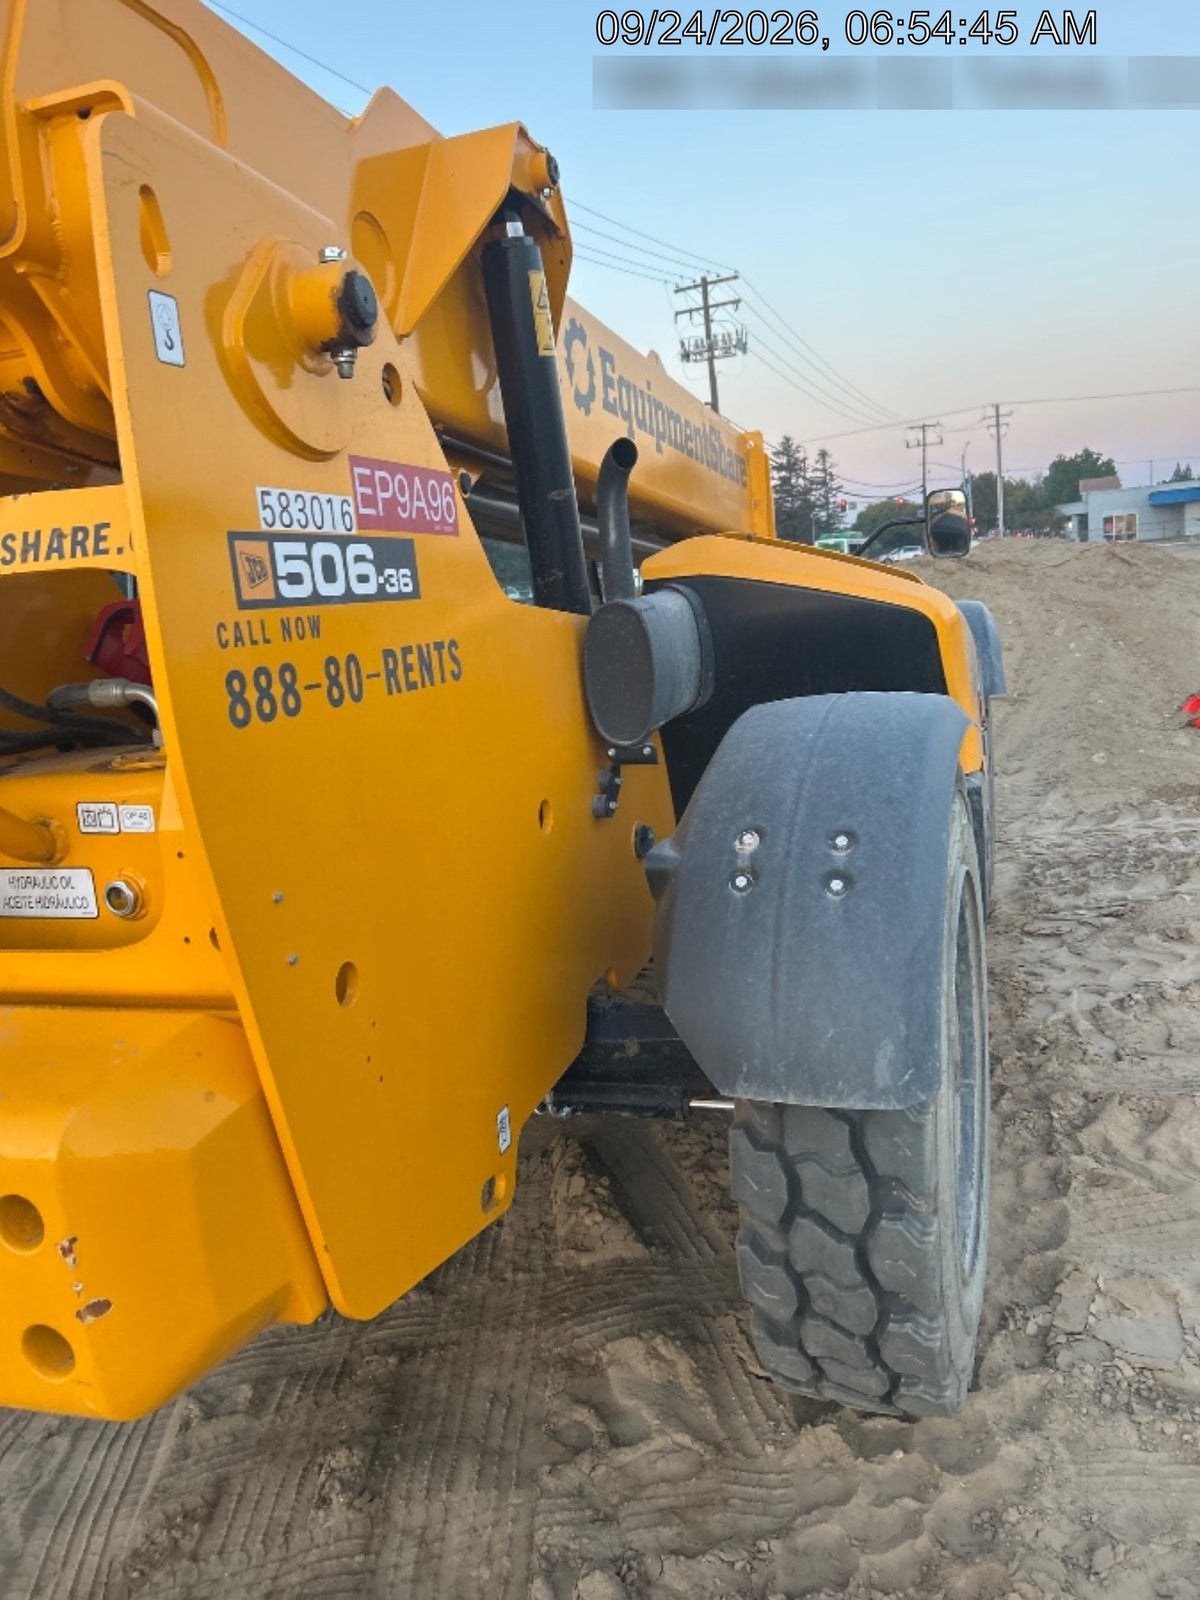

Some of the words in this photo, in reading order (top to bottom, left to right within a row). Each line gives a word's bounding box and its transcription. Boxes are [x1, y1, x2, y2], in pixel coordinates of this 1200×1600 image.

[598, 345, 748, 488] EquipmentShare
[261, 490, 353, 532] 583016
[353, 467, 456, 524] EP9A96
[0, 522, 133, 566] SHARE.
[216, 619, 271, 649] CALL
[281, 615, 321, 642] NOW
[225, 639, 463, 729] 888-80-RENTS
[3, 895, 34, 909] ACEITE
